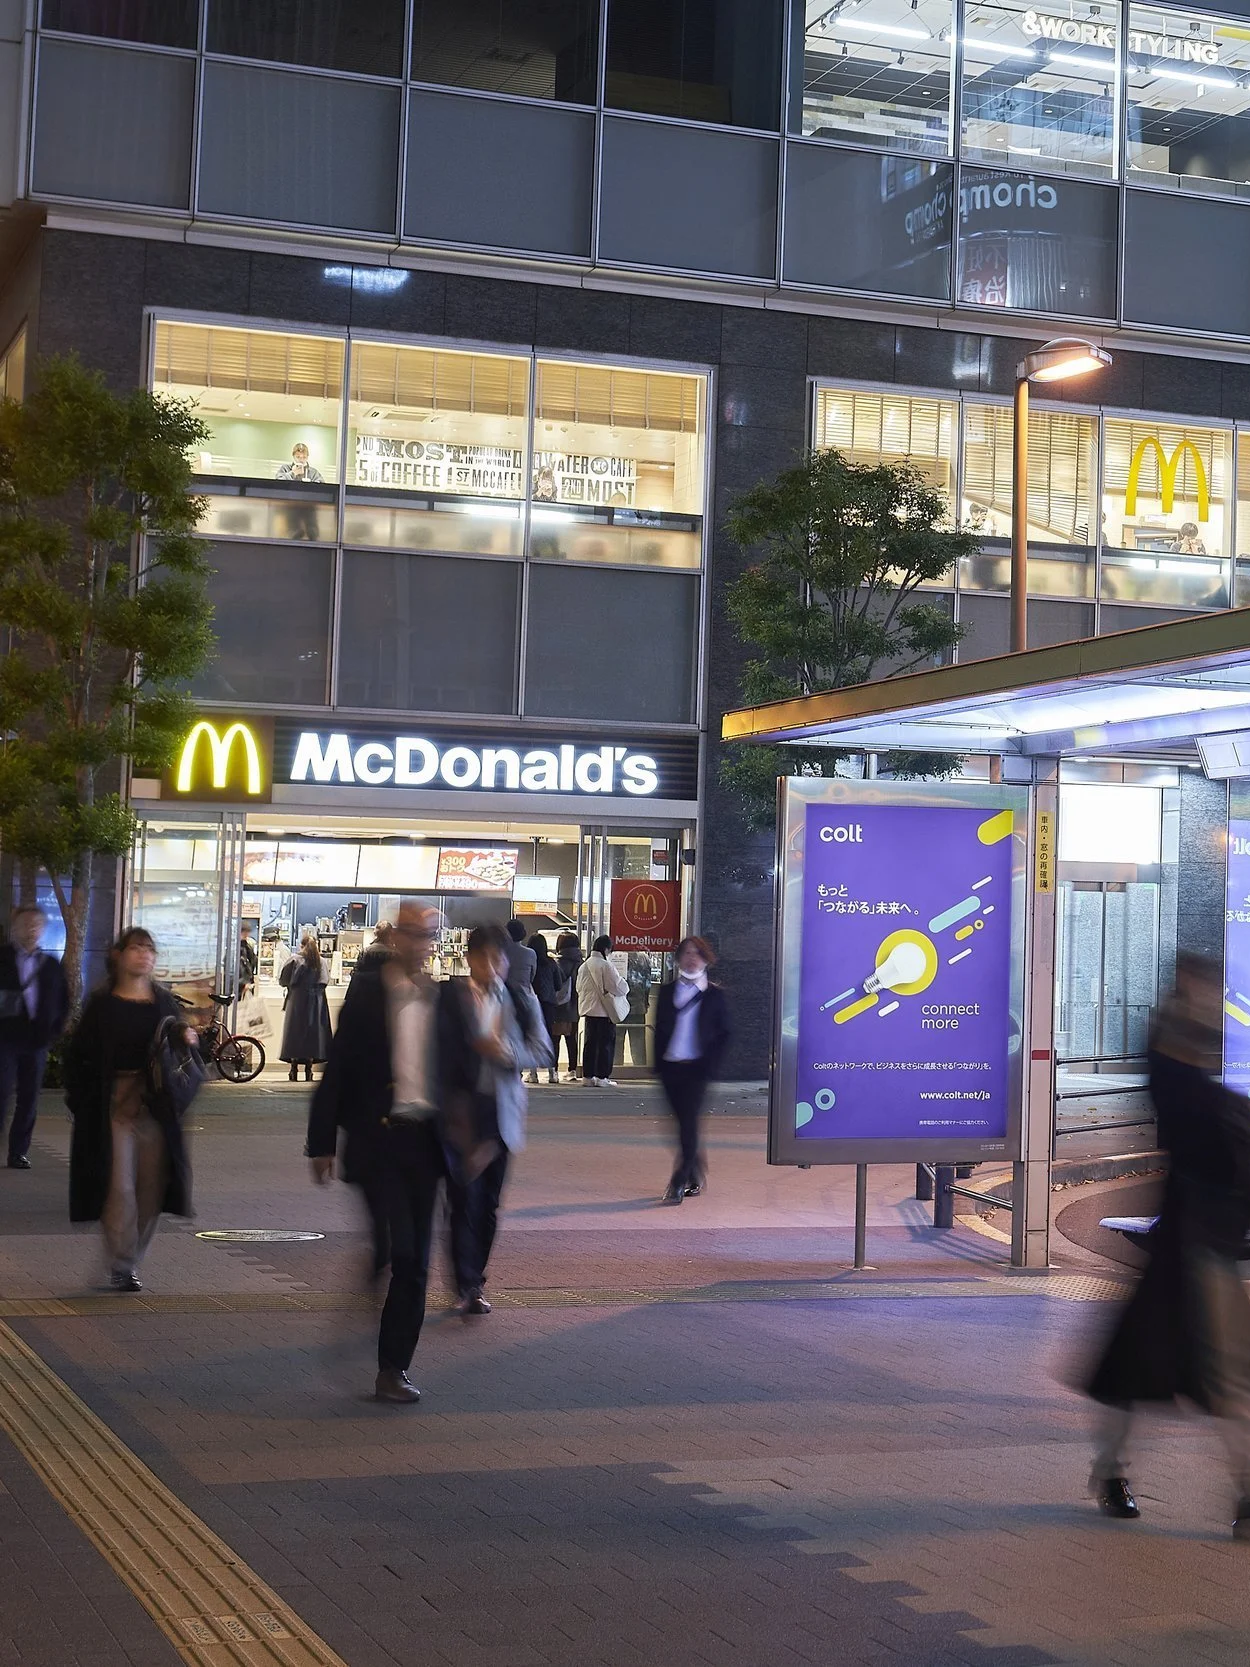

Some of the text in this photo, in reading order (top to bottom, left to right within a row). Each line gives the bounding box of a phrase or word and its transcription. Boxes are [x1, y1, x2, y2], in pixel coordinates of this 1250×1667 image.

[1021, 10, 1219, 64] &WORK TYLING
[376, 438, 468, 464] MOST
[381, 461, 441, 487] COFFEE
[290, 732, 659, 795] McDonald's
[819, 823, 863, 842] colt
[817, 884, 849, 897] もっと
[615, 935, 674, 947] McDelivery
[921, 1003, 980, 1015] connect
[921, 1018, 960, 1030] more
[920, 1090, 991, 1101] www.colt.net/ja
